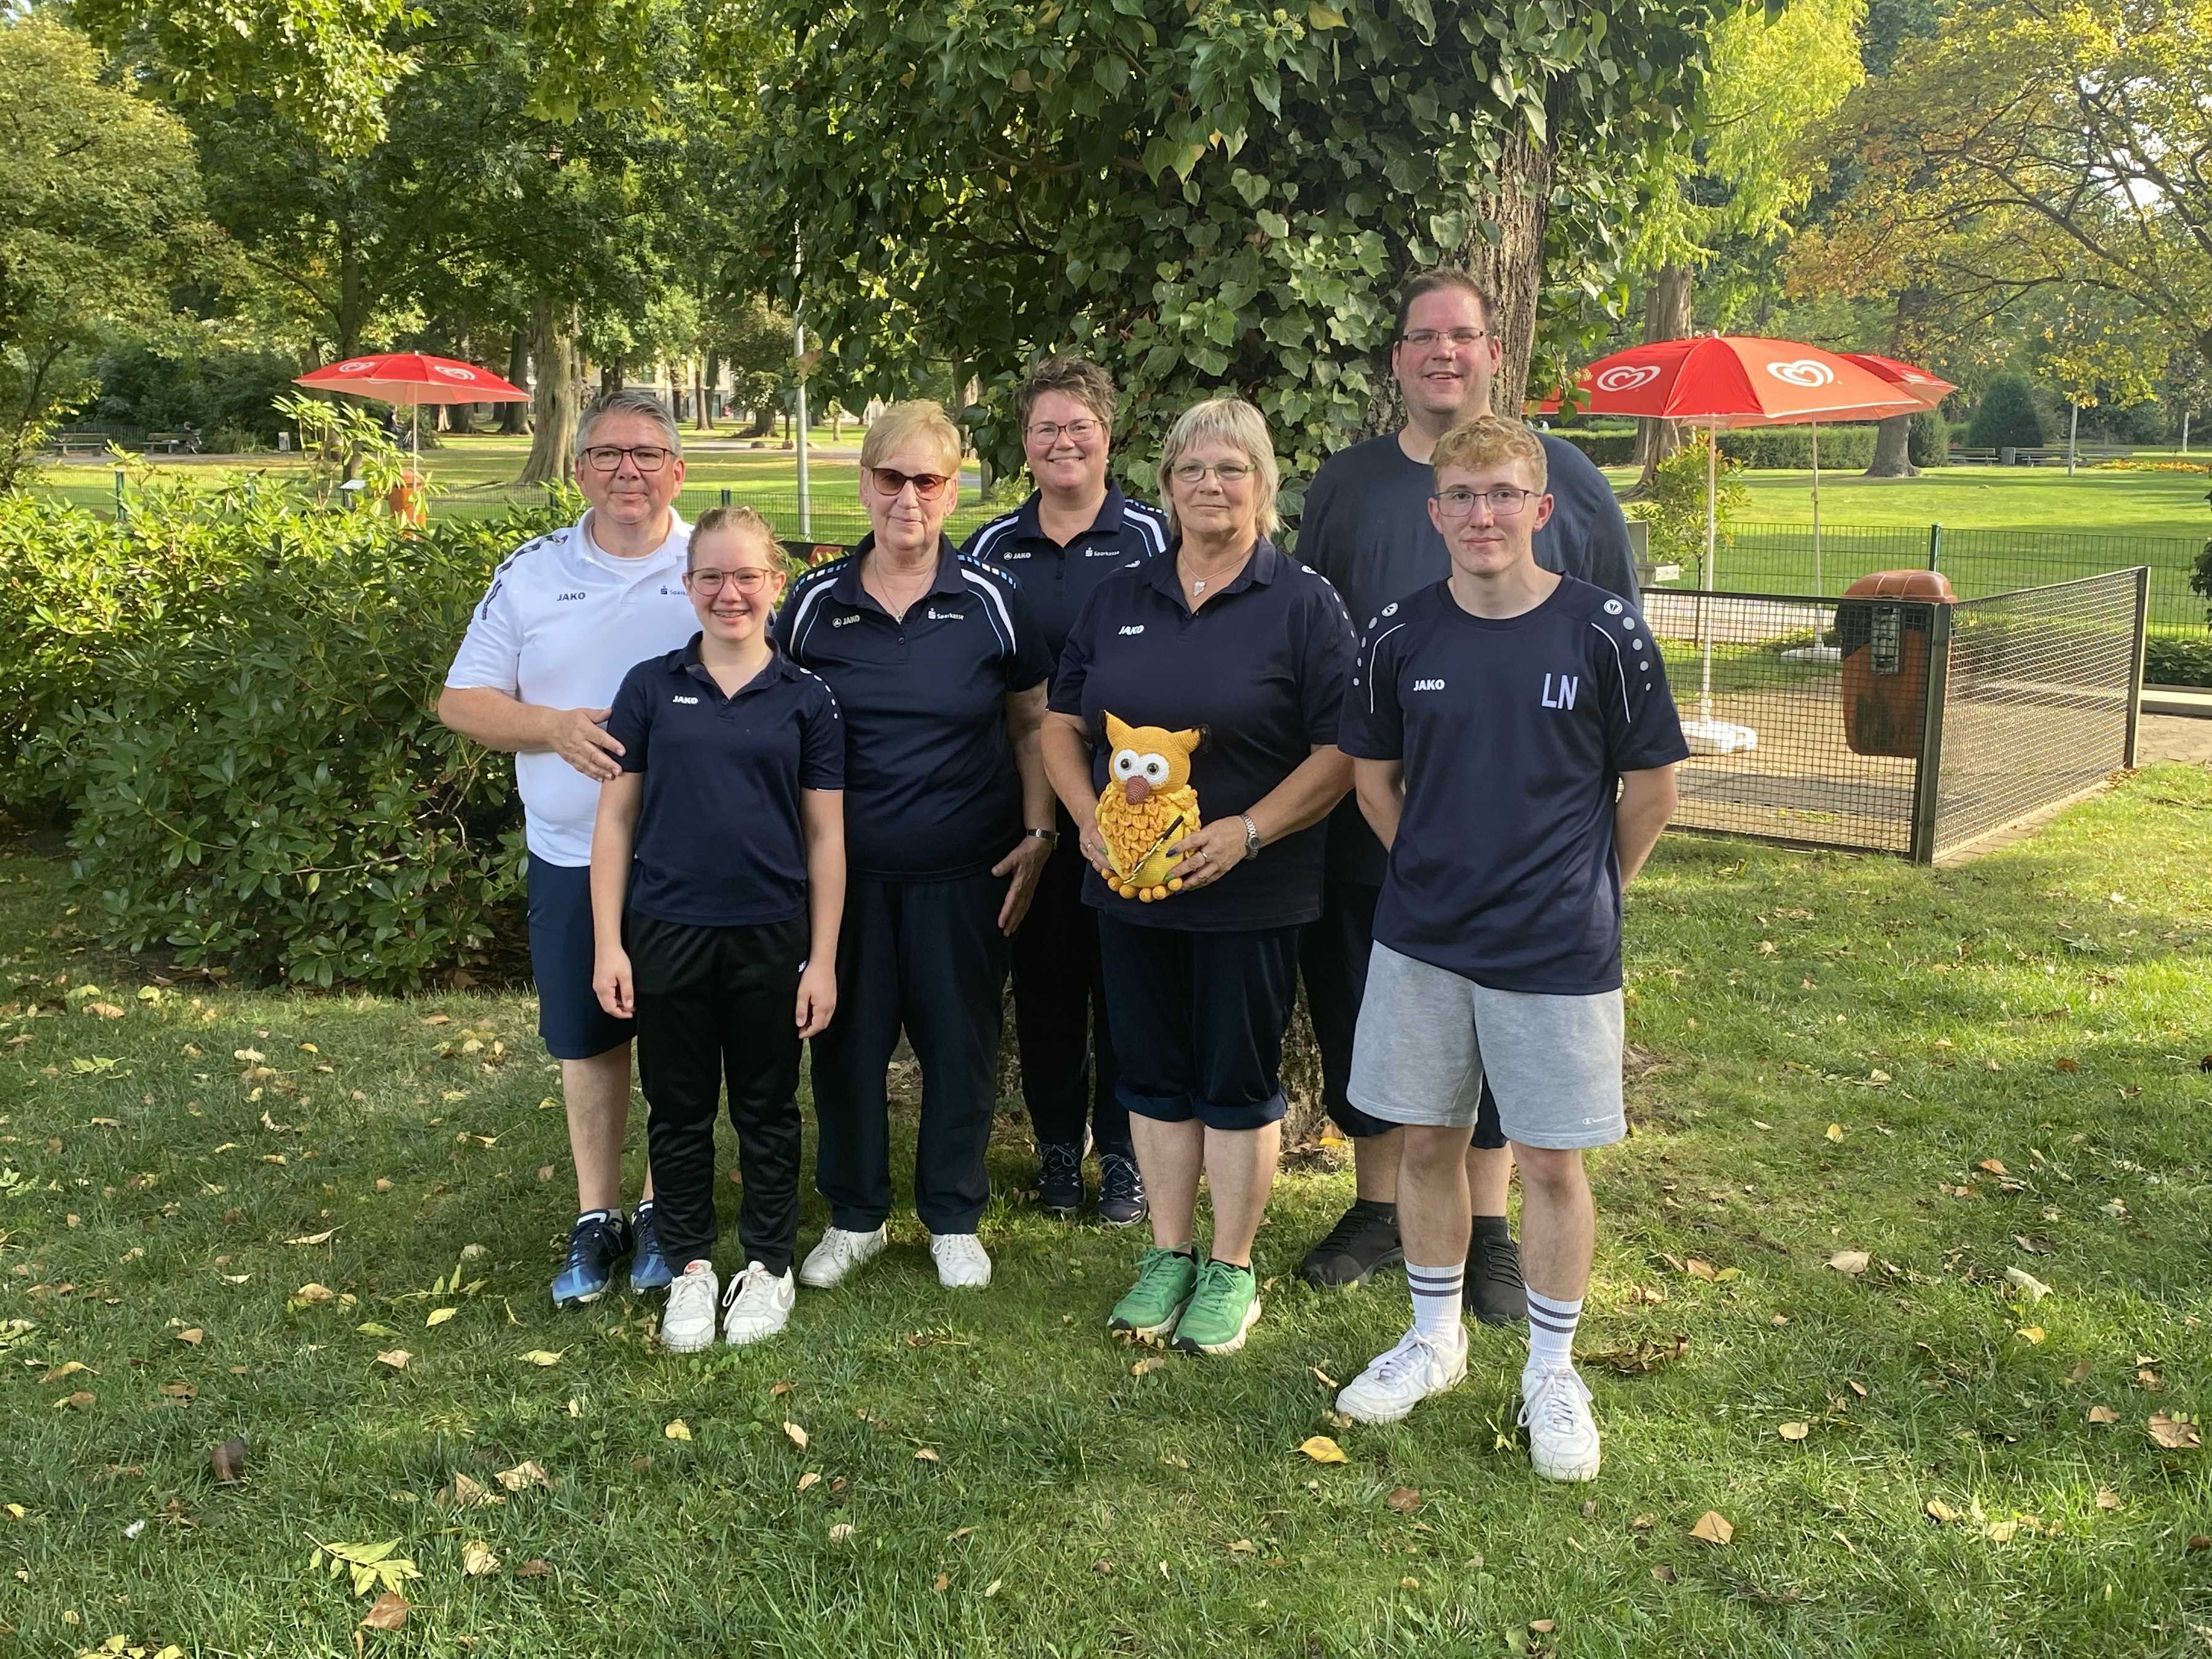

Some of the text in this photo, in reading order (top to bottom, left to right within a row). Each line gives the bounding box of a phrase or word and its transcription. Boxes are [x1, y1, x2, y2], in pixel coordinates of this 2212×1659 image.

[557, 592, 586, 602] JAKO
[842, 615, 860, 625] JAKO
[1118, 624, 1144, 635] JAKO
[1413, 679, 1445, 691] JAKO
[1541, 673, 1579, 710] LN
[673, 695, 698, 704] JAKO
